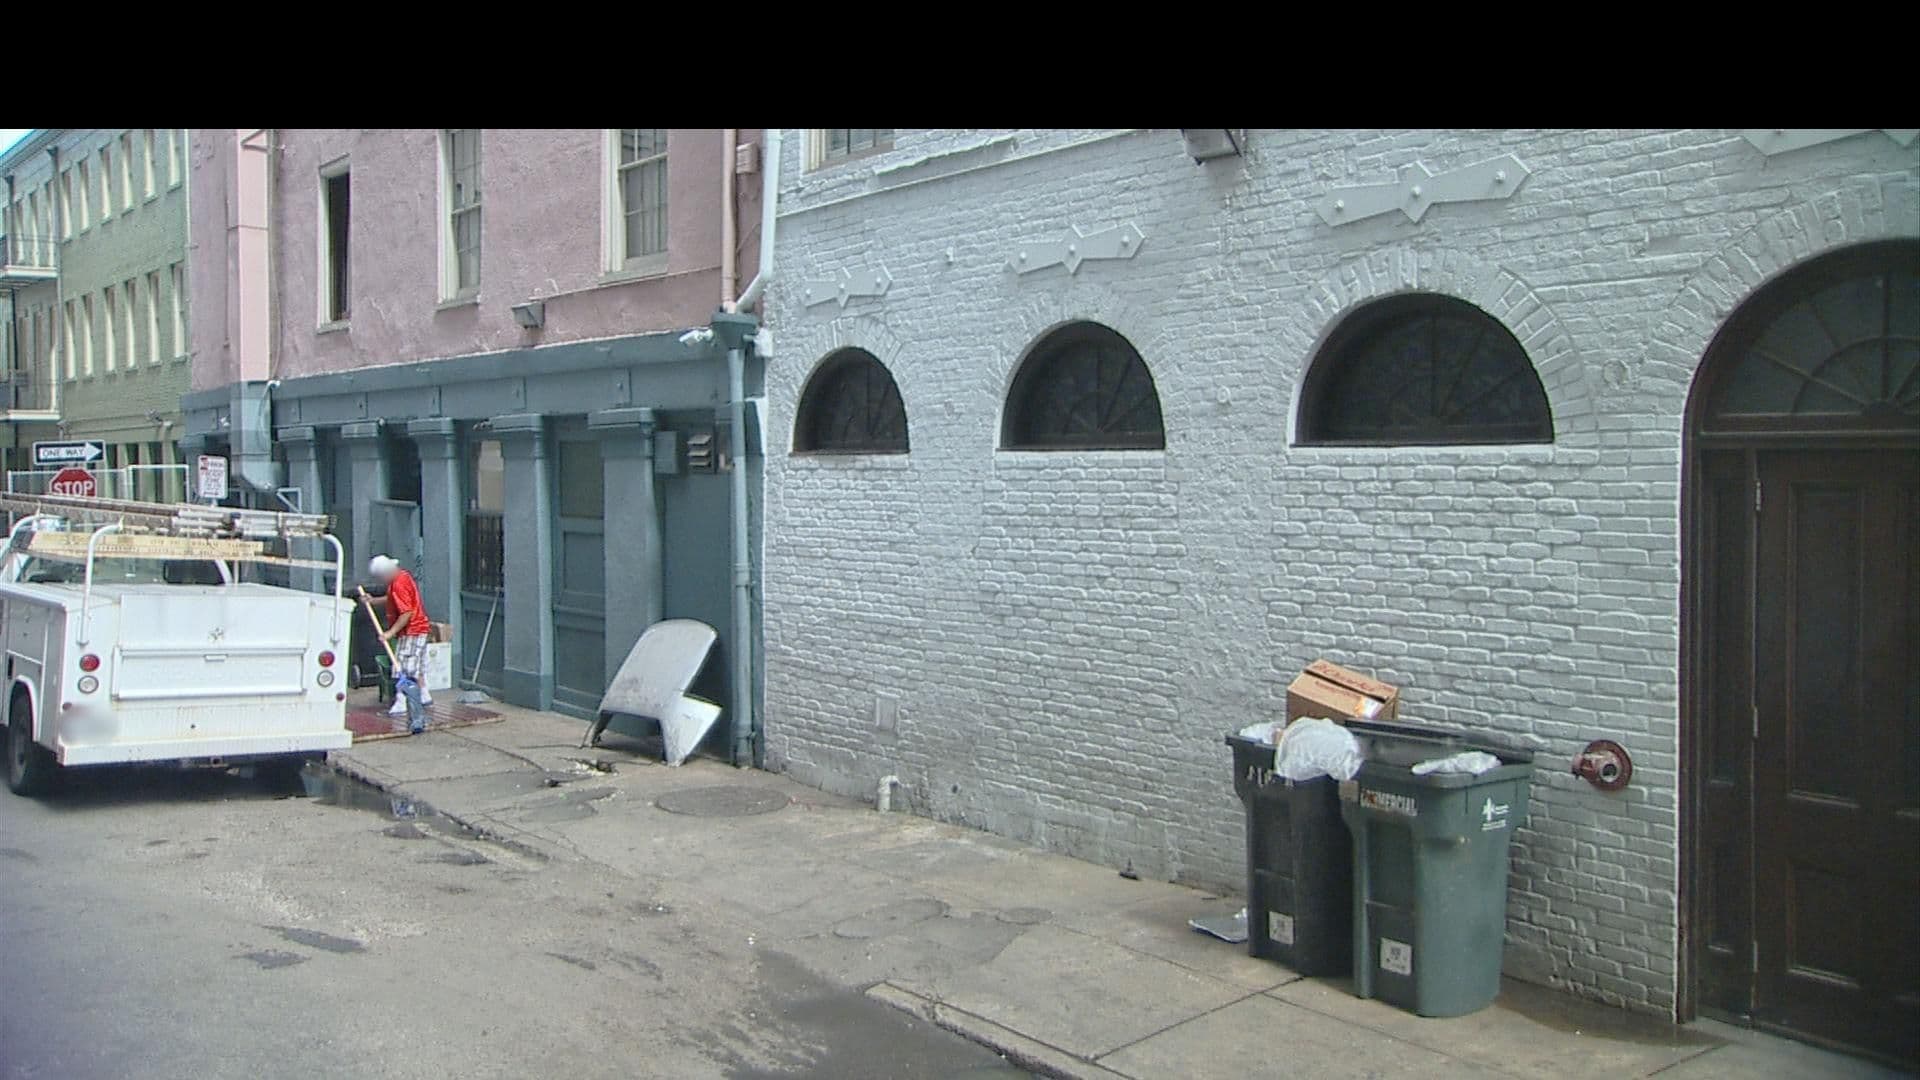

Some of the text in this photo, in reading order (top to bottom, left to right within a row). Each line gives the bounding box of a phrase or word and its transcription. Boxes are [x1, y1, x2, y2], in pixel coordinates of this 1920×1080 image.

[42, 448, 84, 457] ONE WAY
[53, 480, 94, 496] STOP
